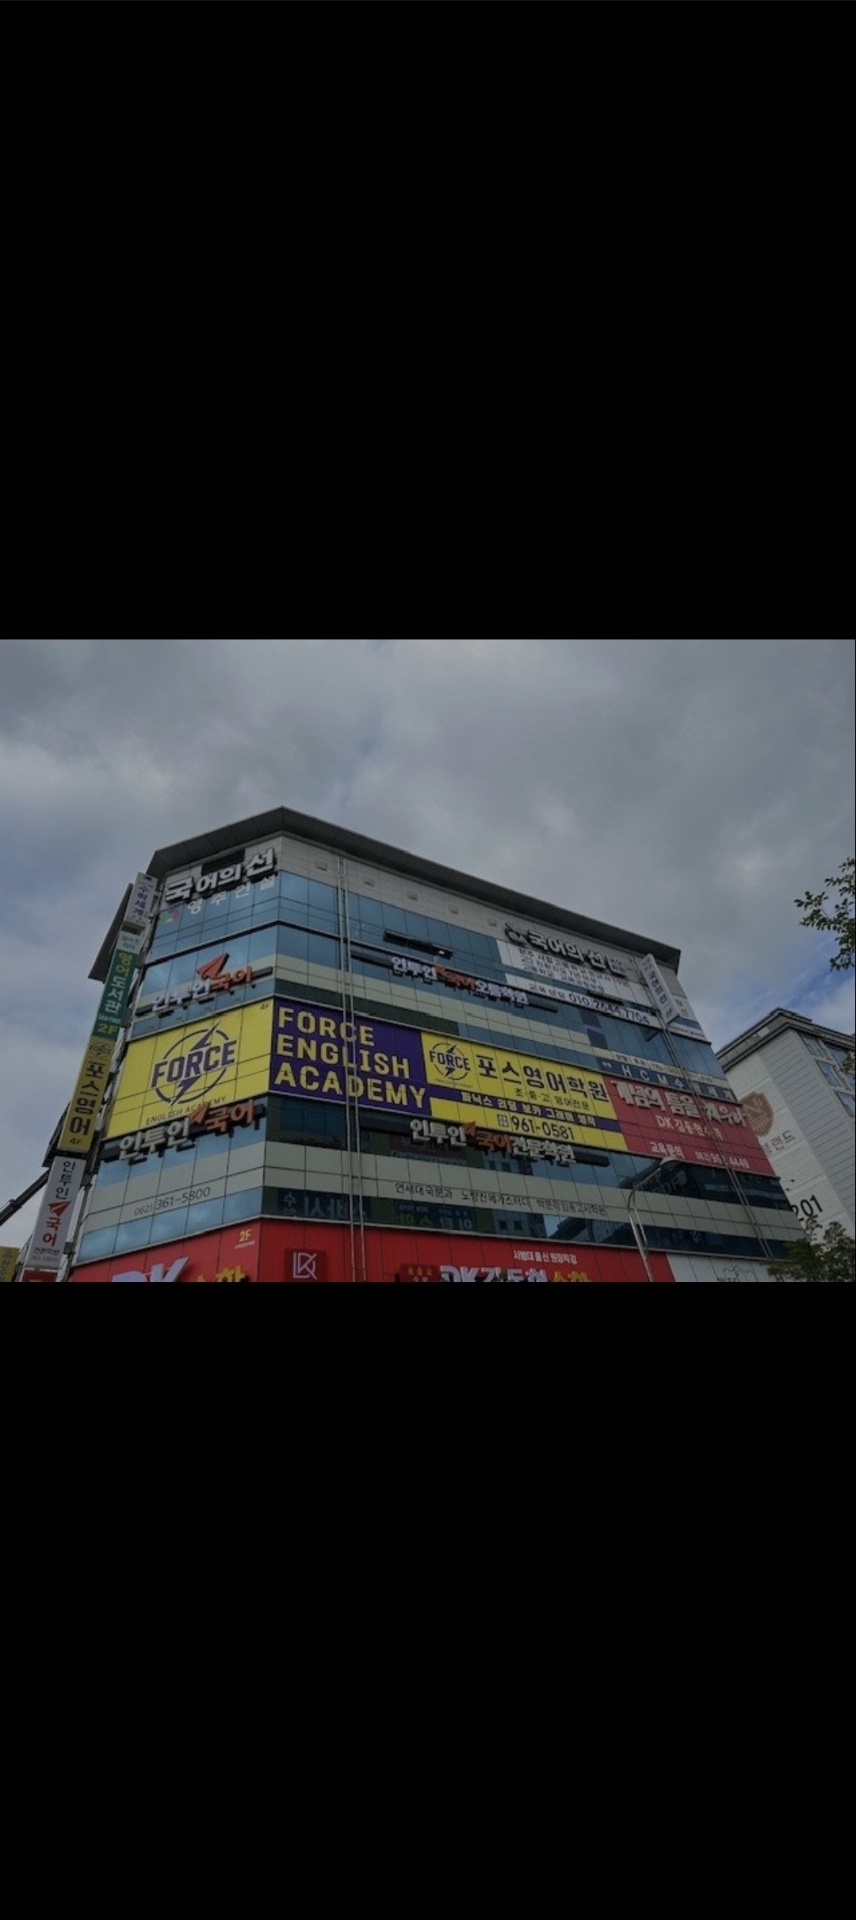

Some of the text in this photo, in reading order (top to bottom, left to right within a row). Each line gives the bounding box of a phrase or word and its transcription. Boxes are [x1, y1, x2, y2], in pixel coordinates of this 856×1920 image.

[278, 1006, 375, 1047] FORCE
[151, 1039, 238, 1088] FORCE
[276, 1033, 411, 1080] ENGLISH
[429, 1050, 471, 1072] FORCE
[476, 1054, 609, 1103] 포스영어학원
[69, 1060, 107, 1136] 포스영어
[273, 1061, 427, 1109] ACADEMY
[118, 1097, 255, 1161] 인투인 국어
[408, 1116, 468, 1148] 인투인
[510, 1115, 575, 1141] 961-0581
[42, 1160, 77, 1247] 인투인 국어
[238, 1229, 253, 1244] 2F
